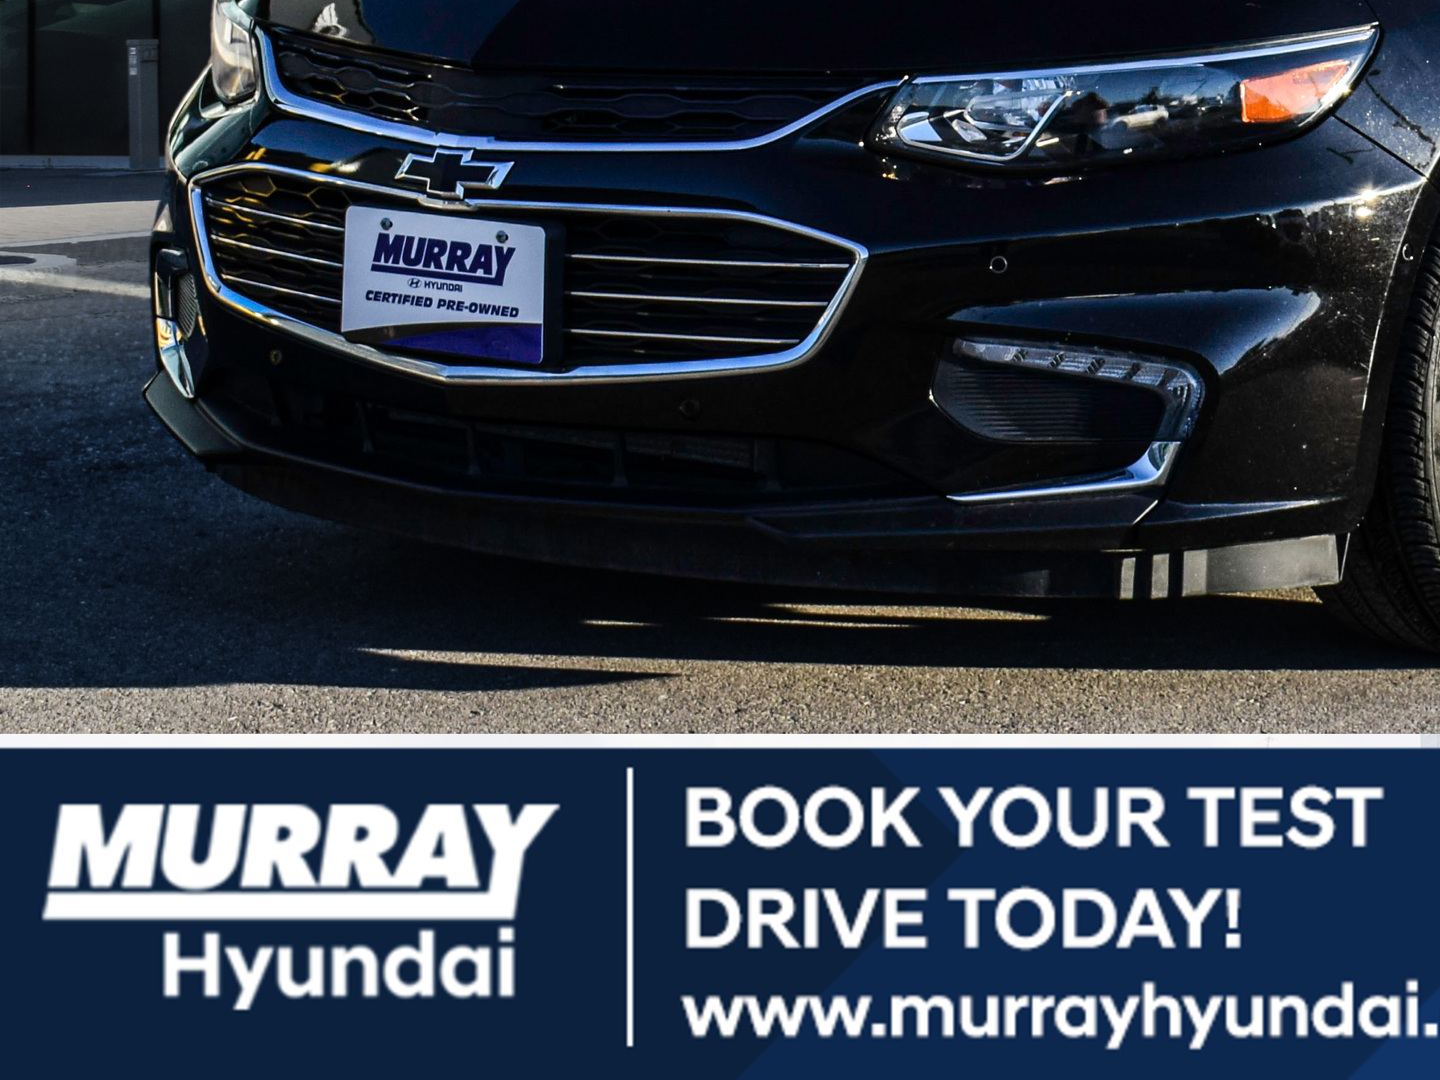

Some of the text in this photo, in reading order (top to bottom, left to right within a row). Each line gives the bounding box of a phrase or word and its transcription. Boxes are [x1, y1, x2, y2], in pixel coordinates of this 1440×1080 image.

[371, 232, 516, 286] MURRAY
[424, 281, 463, 293] HYUNDAI
[365, 290, 520, 318] CERTIFIED PRE-OWNED
